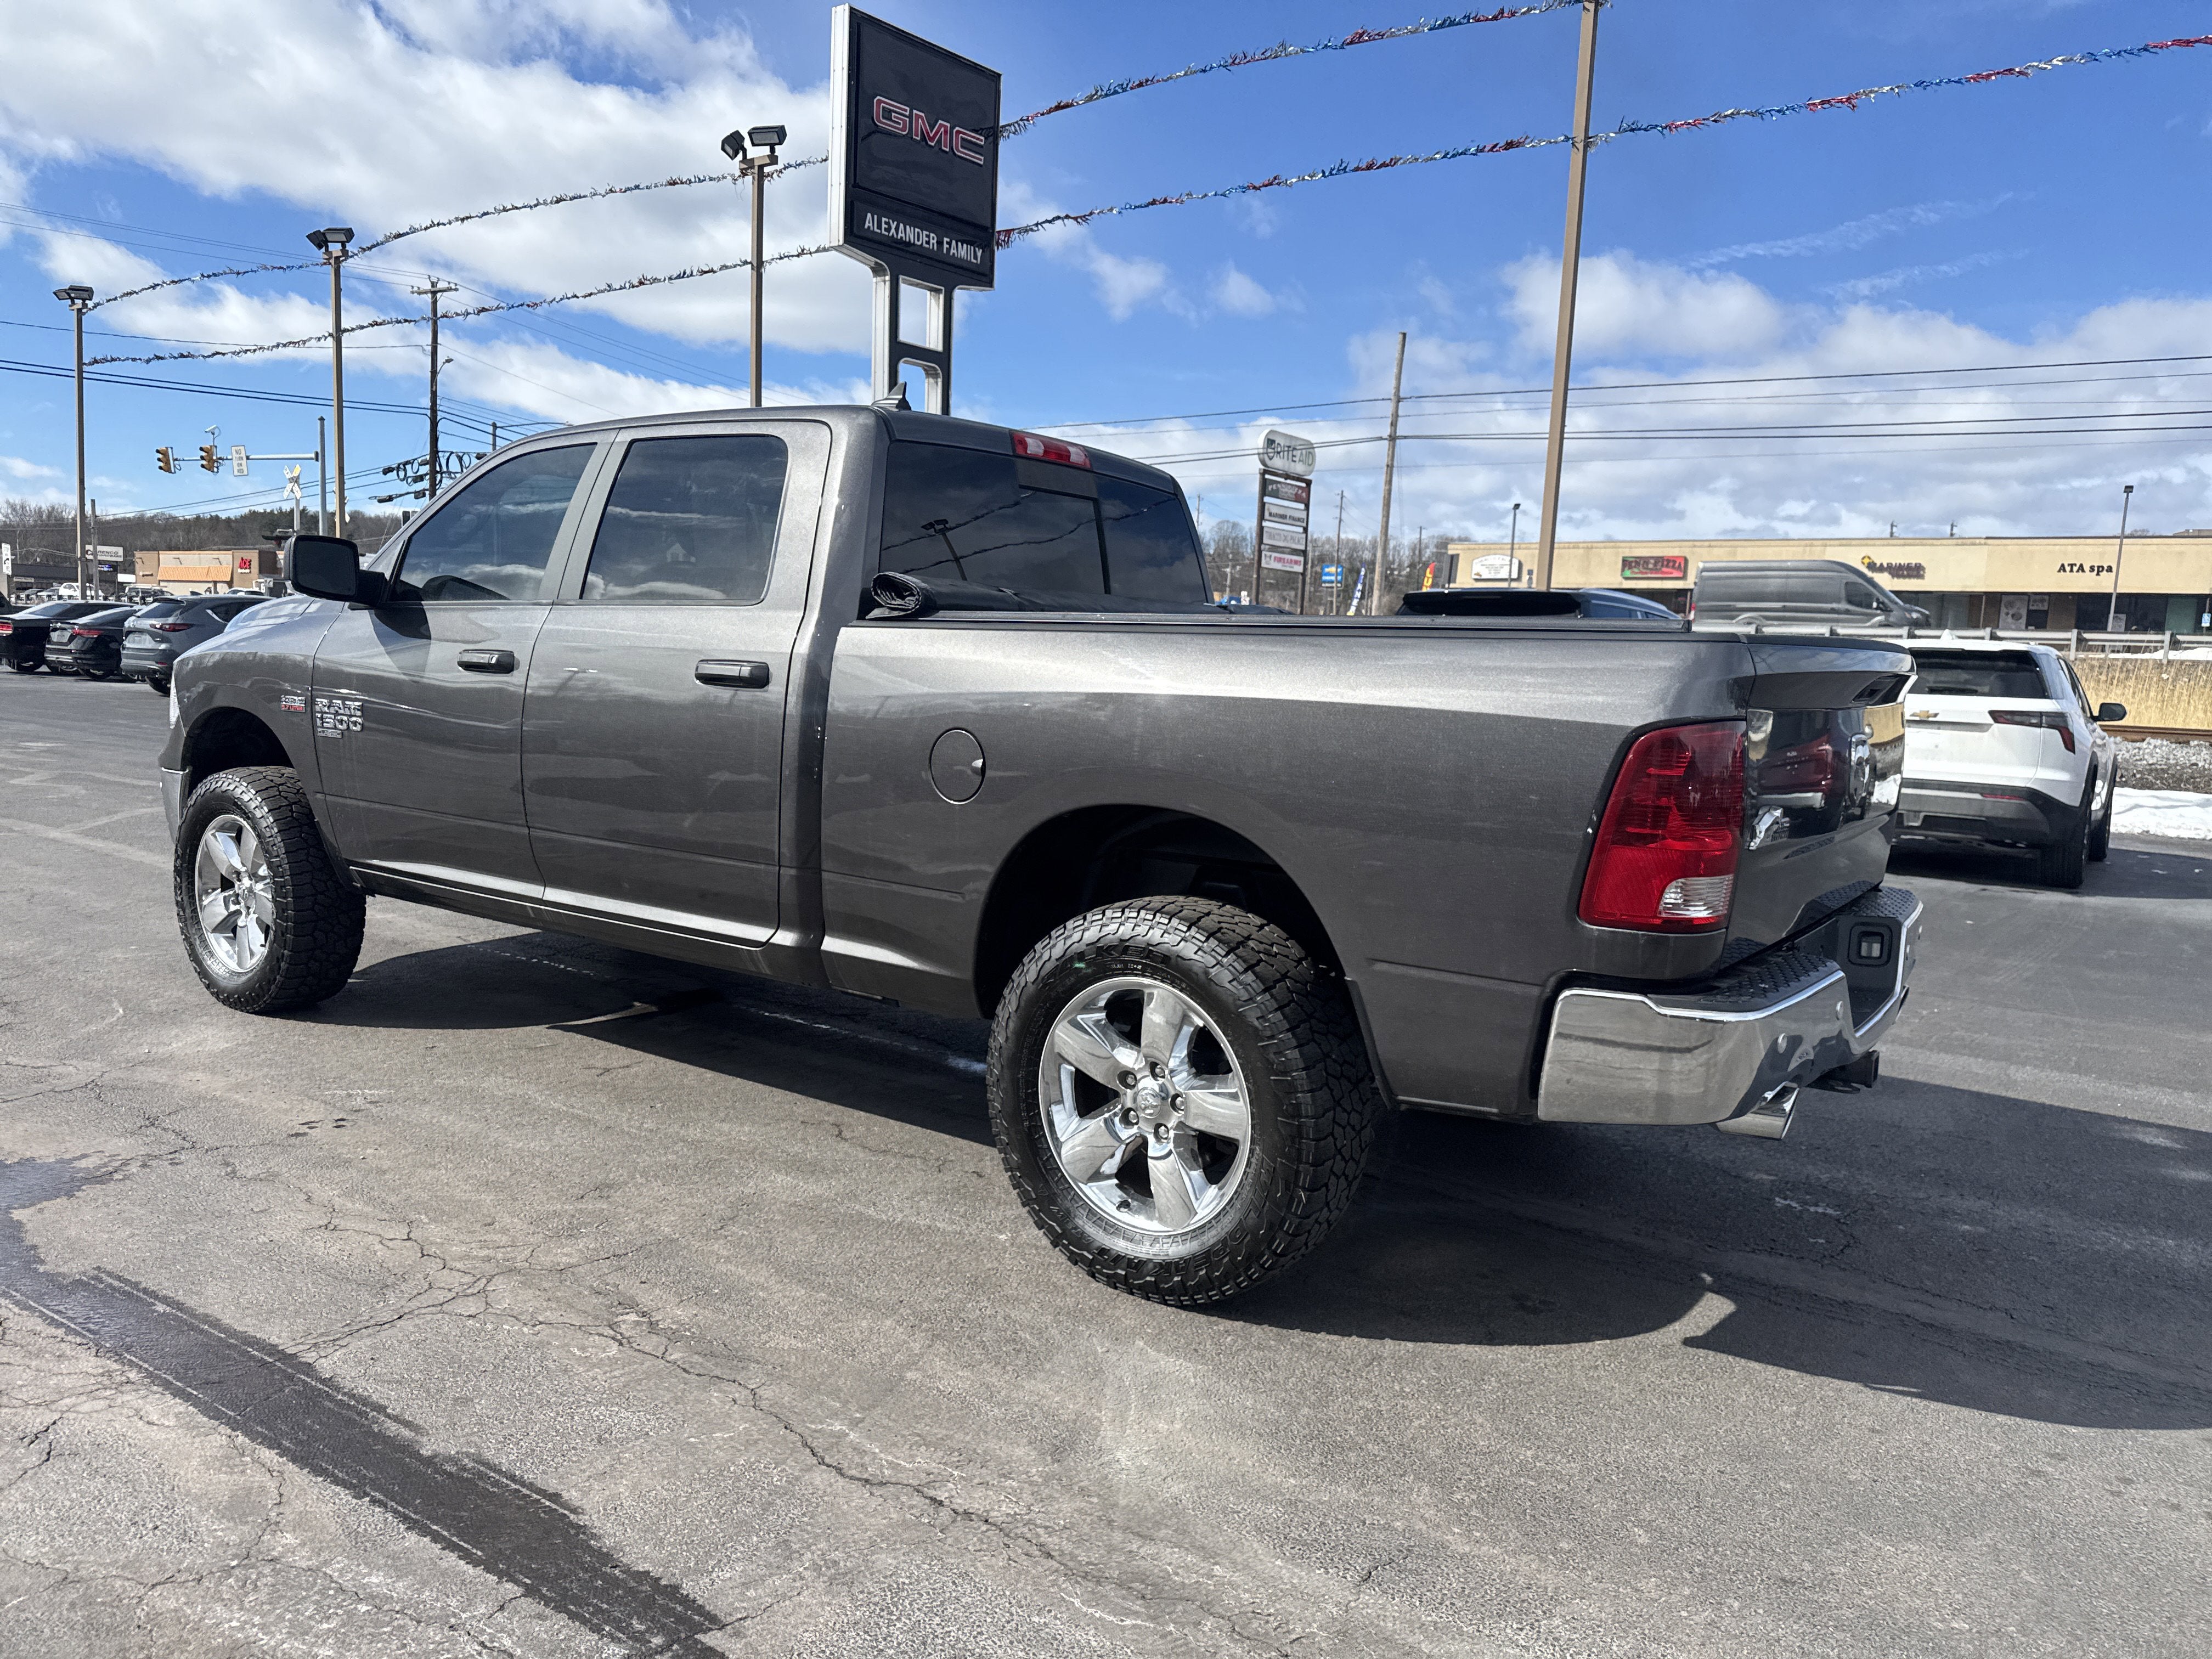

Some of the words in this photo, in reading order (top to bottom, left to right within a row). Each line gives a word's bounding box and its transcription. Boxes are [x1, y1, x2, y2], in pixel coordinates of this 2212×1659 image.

[873, 95, 985, 165] GMC
[864, 212, 937, 251] ALEXANDER
[943, 237, 983, 264] FAMILY
[1276, 442, 1296, 462] RITE
[1298, 450, 1314, 466] AID
[238, 556, 251, 569] ACE
[1273, 556, 1302, 566] FIREARMS
[2057, 562, 2086, 573] ATA
[2089, 565, 2113, 576] spa
[315, 713, 364, 732] 1500
[1091, 1247, 1148, 1274] A/T
